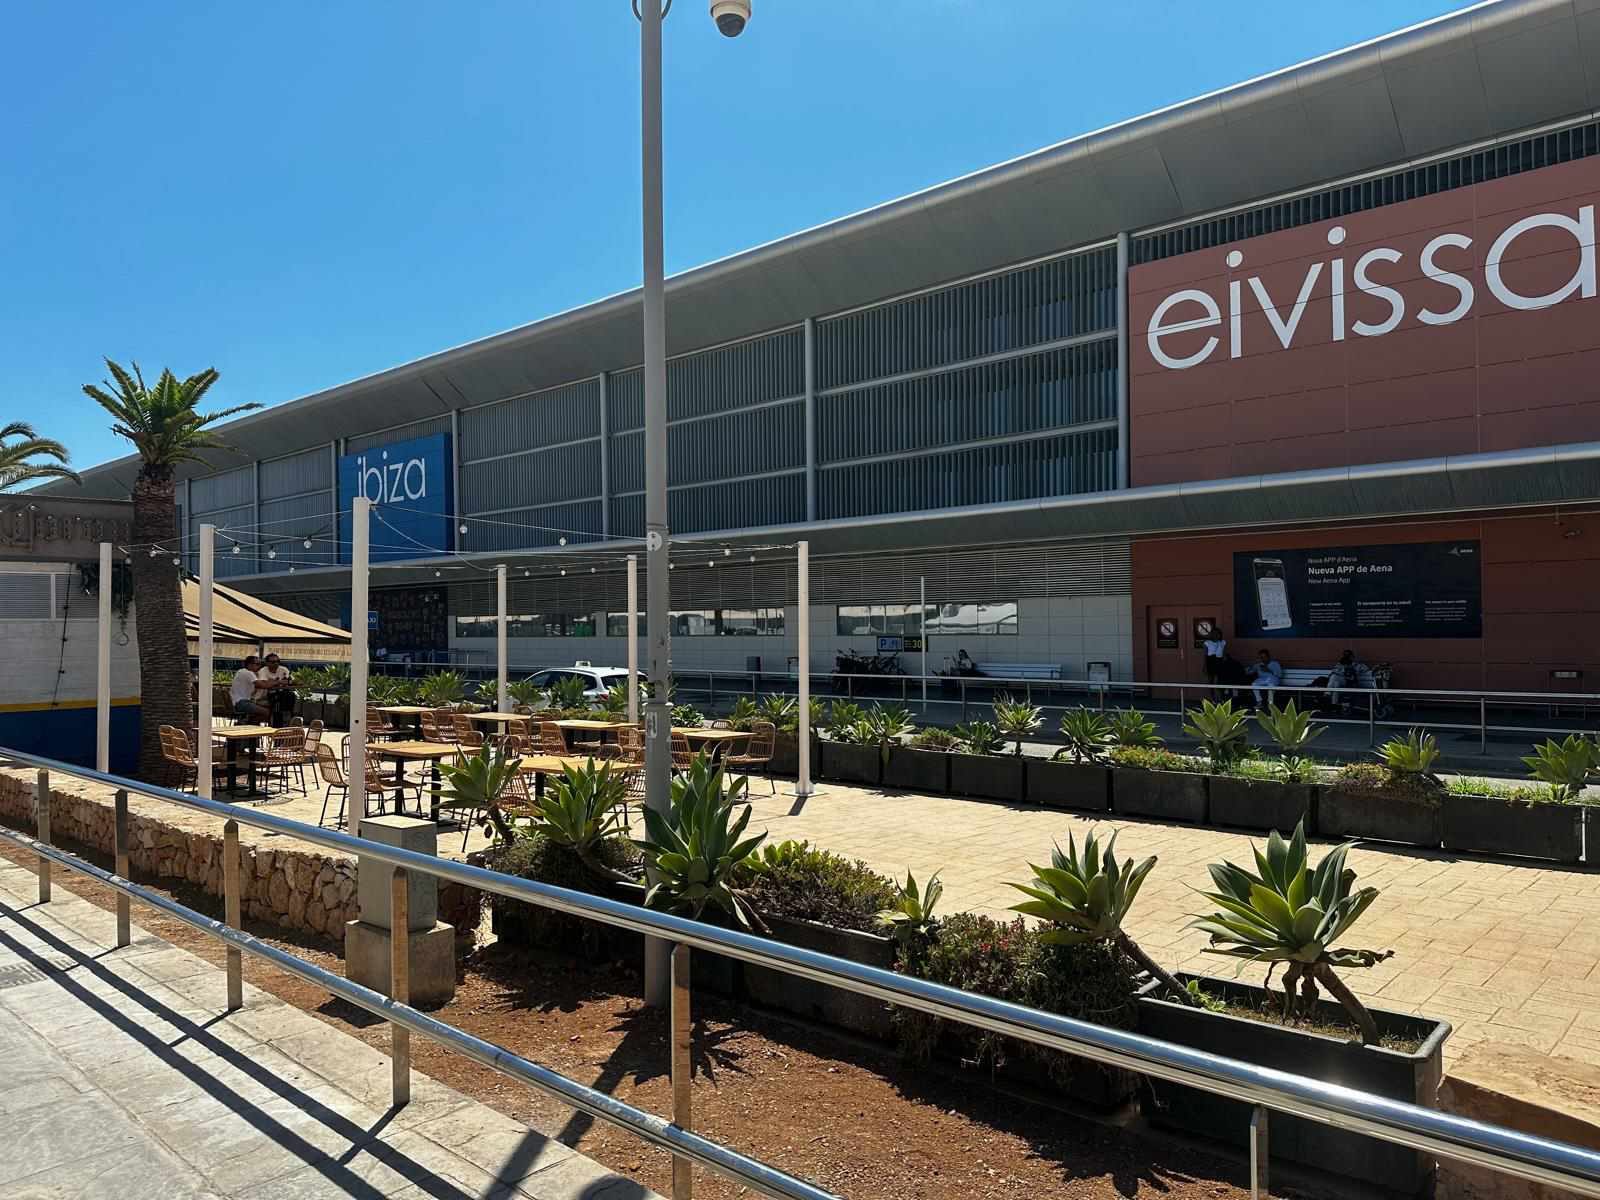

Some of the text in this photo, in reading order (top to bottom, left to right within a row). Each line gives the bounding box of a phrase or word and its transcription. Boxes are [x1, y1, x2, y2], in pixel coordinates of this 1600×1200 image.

[1146, 204, 1598, 370] eivissa
[357, 450, 426, 504] ibiza
[1308, 564, 1393, 575] Nueva APP de Aena
